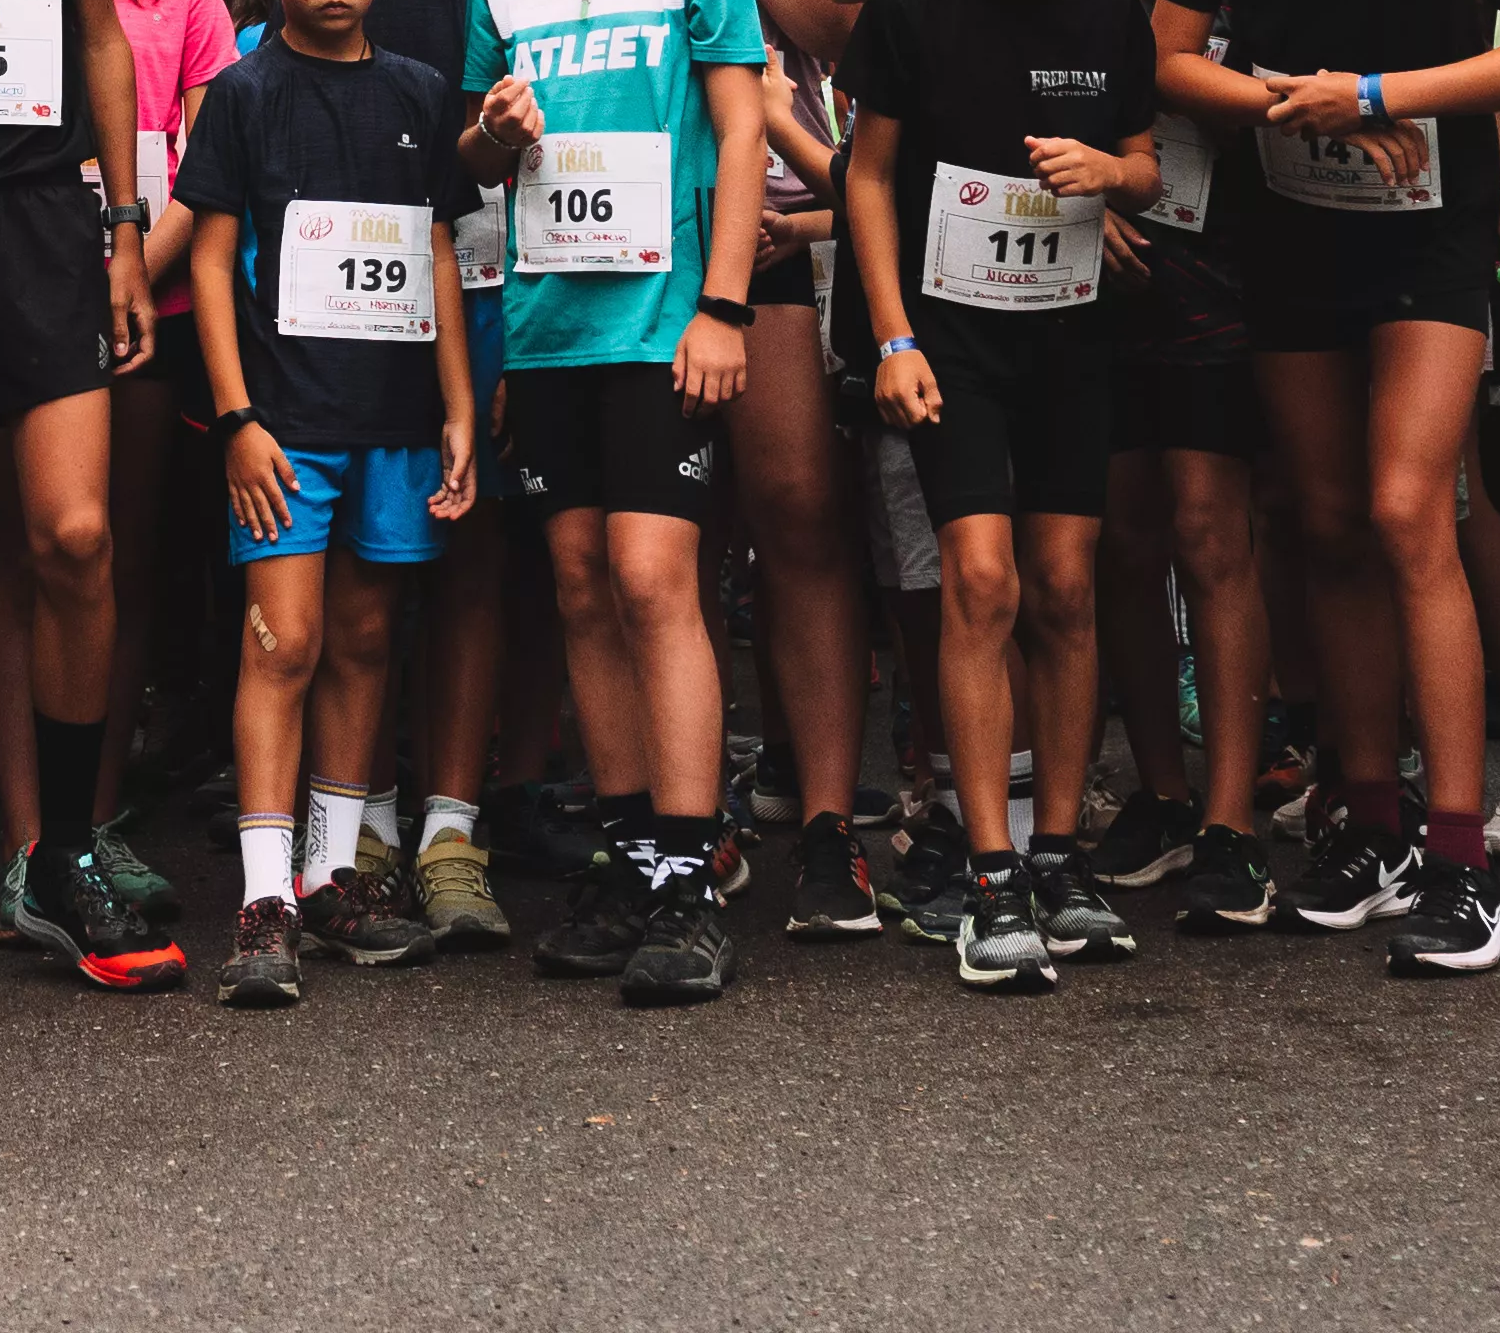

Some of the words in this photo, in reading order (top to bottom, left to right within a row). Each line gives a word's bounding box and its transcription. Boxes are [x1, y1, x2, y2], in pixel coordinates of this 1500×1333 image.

[513, 23, 670, 83] ATLEET
[1029, 70, 1069, 93] FREDI
[1071, 70, 1108, 93] TEAM
[556, 147, 608, 173] TRAIL
[547, 188, 613, 223] 106
[1004, 192, 1060, 217] TRAIL
[351, 218, 403, 244] TRAIL
[987, 229, 1060, 265] 111
[337, 257, 407, 293] 139
[986, 268, 1039, 283] NICOLAS
